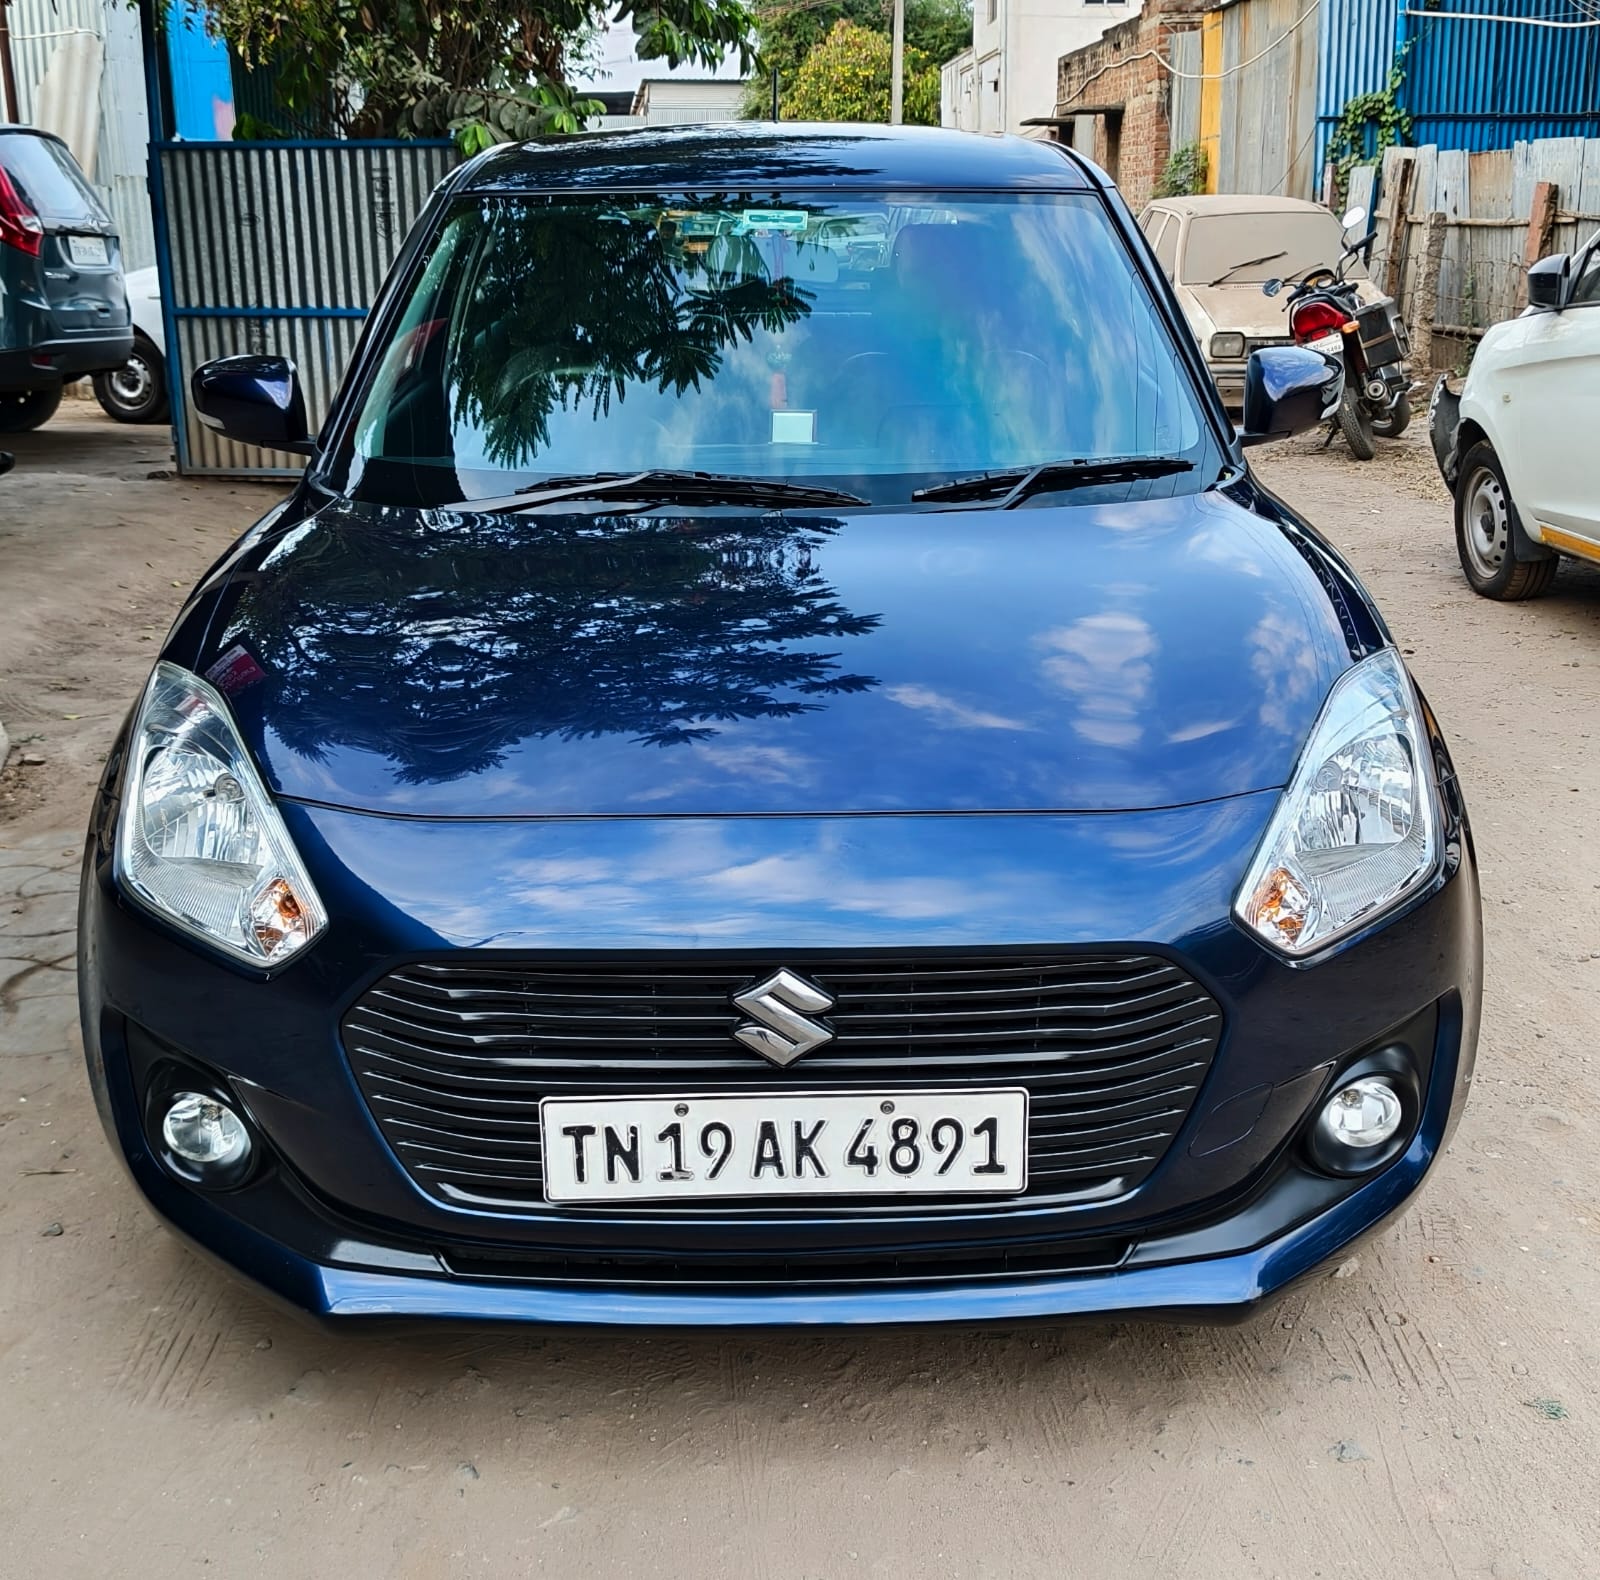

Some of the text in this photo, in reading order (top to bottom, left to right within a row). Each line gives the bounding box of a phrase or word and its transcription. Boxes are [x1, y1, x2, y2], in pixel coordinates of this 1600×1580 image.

[561, 1116, 1006, 1183] TN 19 AK 4891
